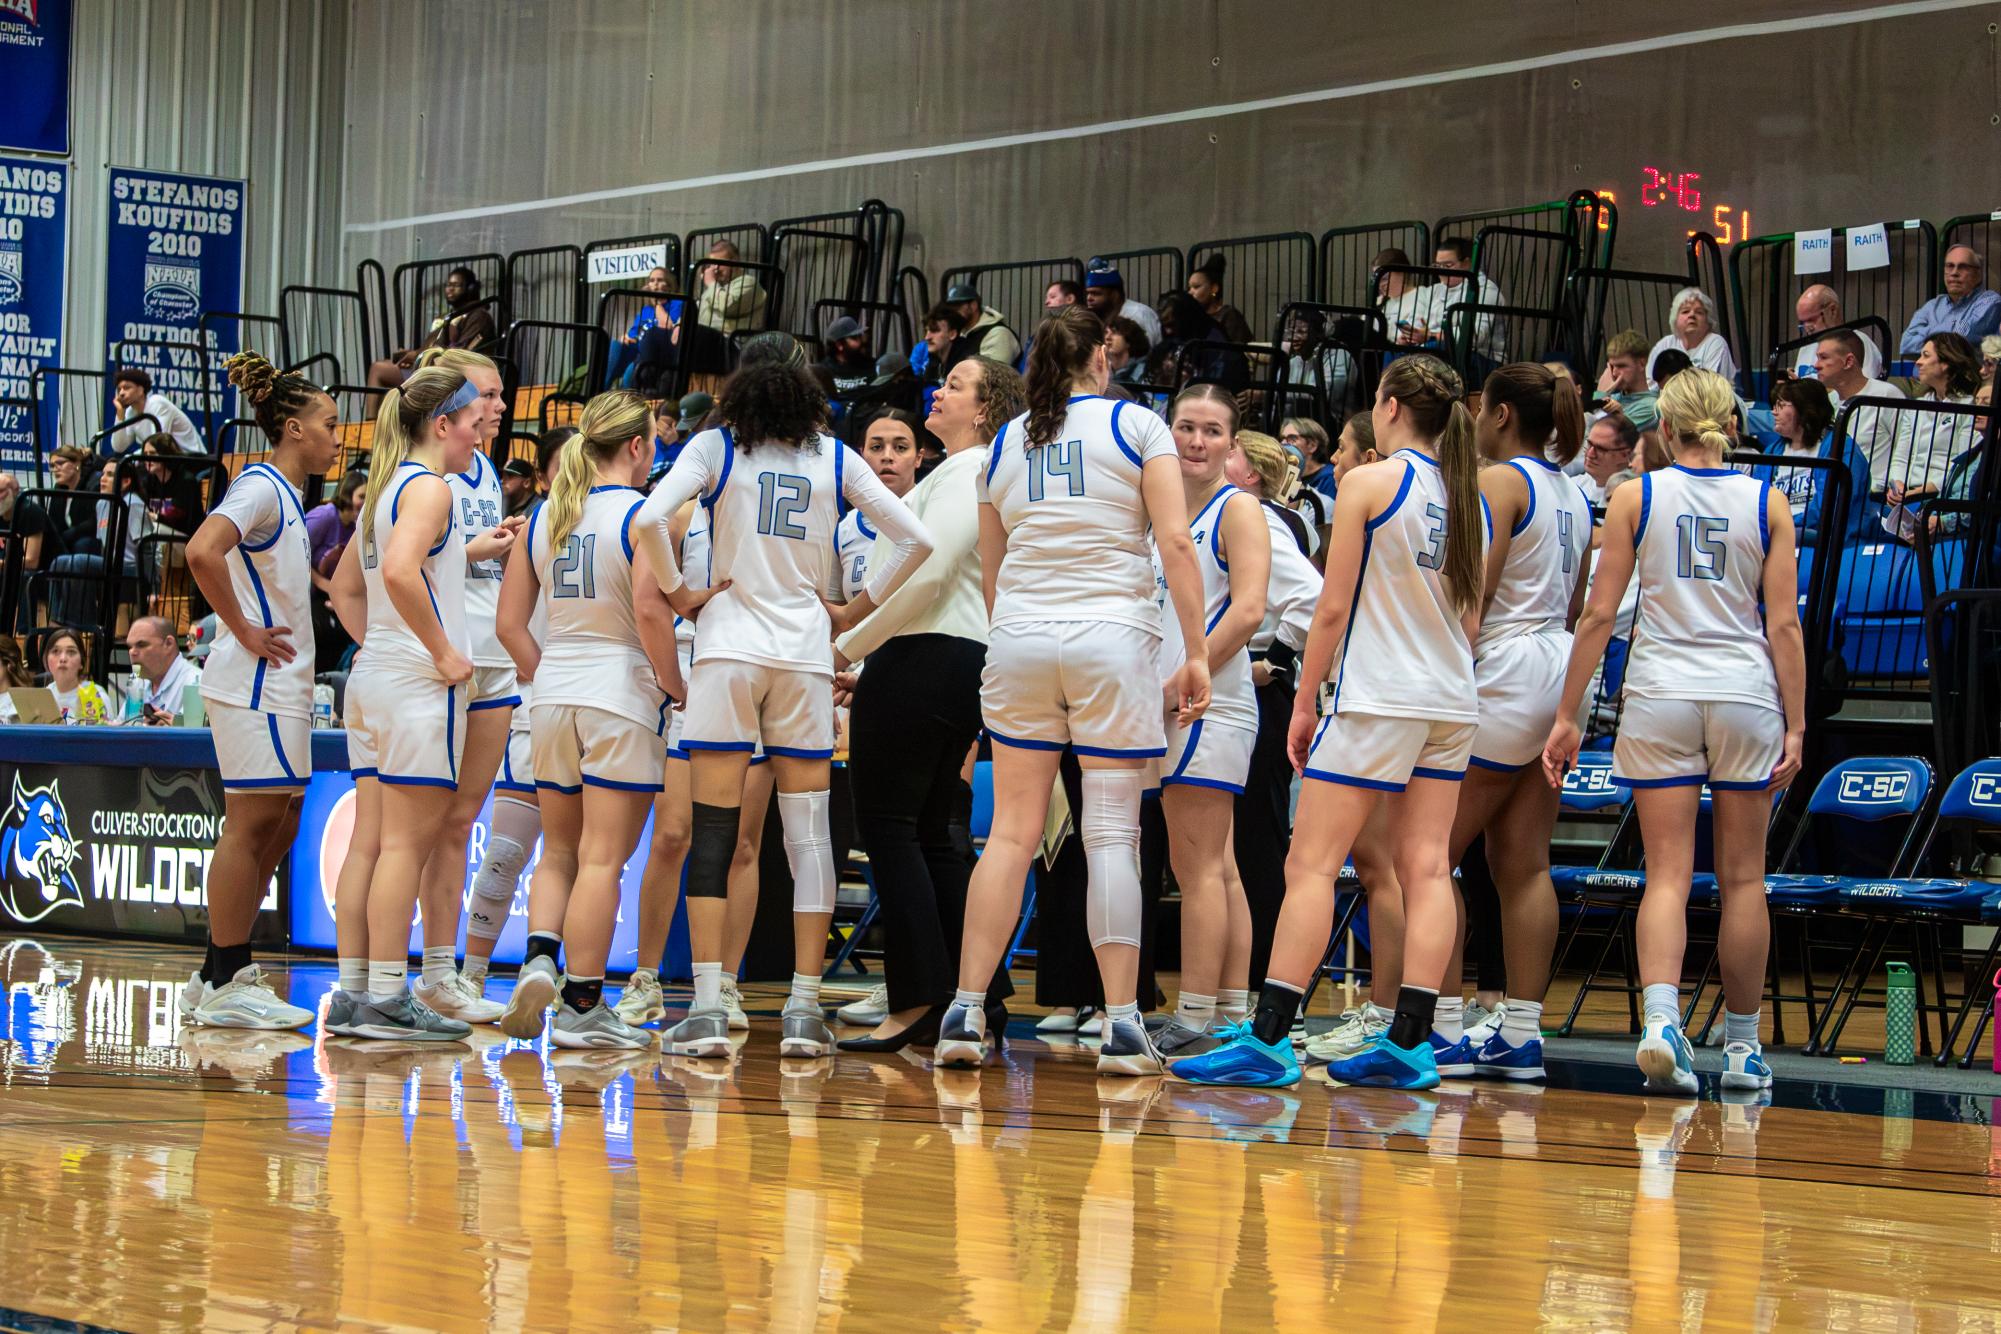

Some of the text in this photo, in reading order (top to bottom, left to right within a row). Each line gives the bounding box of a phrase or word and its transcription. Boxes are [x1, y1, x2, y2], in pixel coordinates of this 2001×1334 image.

[0, 32, 44, 47] AMENT
[114, 176, 239, 211] STEFANOS
[1641, 166, 1701, 212] 2:46
[0, 191, 56, 218] IDIS
[118, 202, 233, 236] KOUFIDIS
[1714, 204, 1749, 244] 51
[147, 231, 202, 258] 2010
[1802, 238, 1829, 250] RAITH
[1854, 233, 1883, 246] RAITH
[147, 265, 197, 292] NAIA
[594, 252, 658, 275] VISITORS
[1025, 439, 1085, 502] 14
[461, 497, 499, 527] C-SC
[757, 471, 812, 540] 12
[1556, 509, 1573, 574] 4
[1676, 514, 1730, 581] 15
[552, 533, 596, 599] 21
[1842, 776, 1908, 798] C-SC
[91, 810, 215, 840] CULVER-STOCKTON
[1586, 874, 1639, 888] WILDCATS
